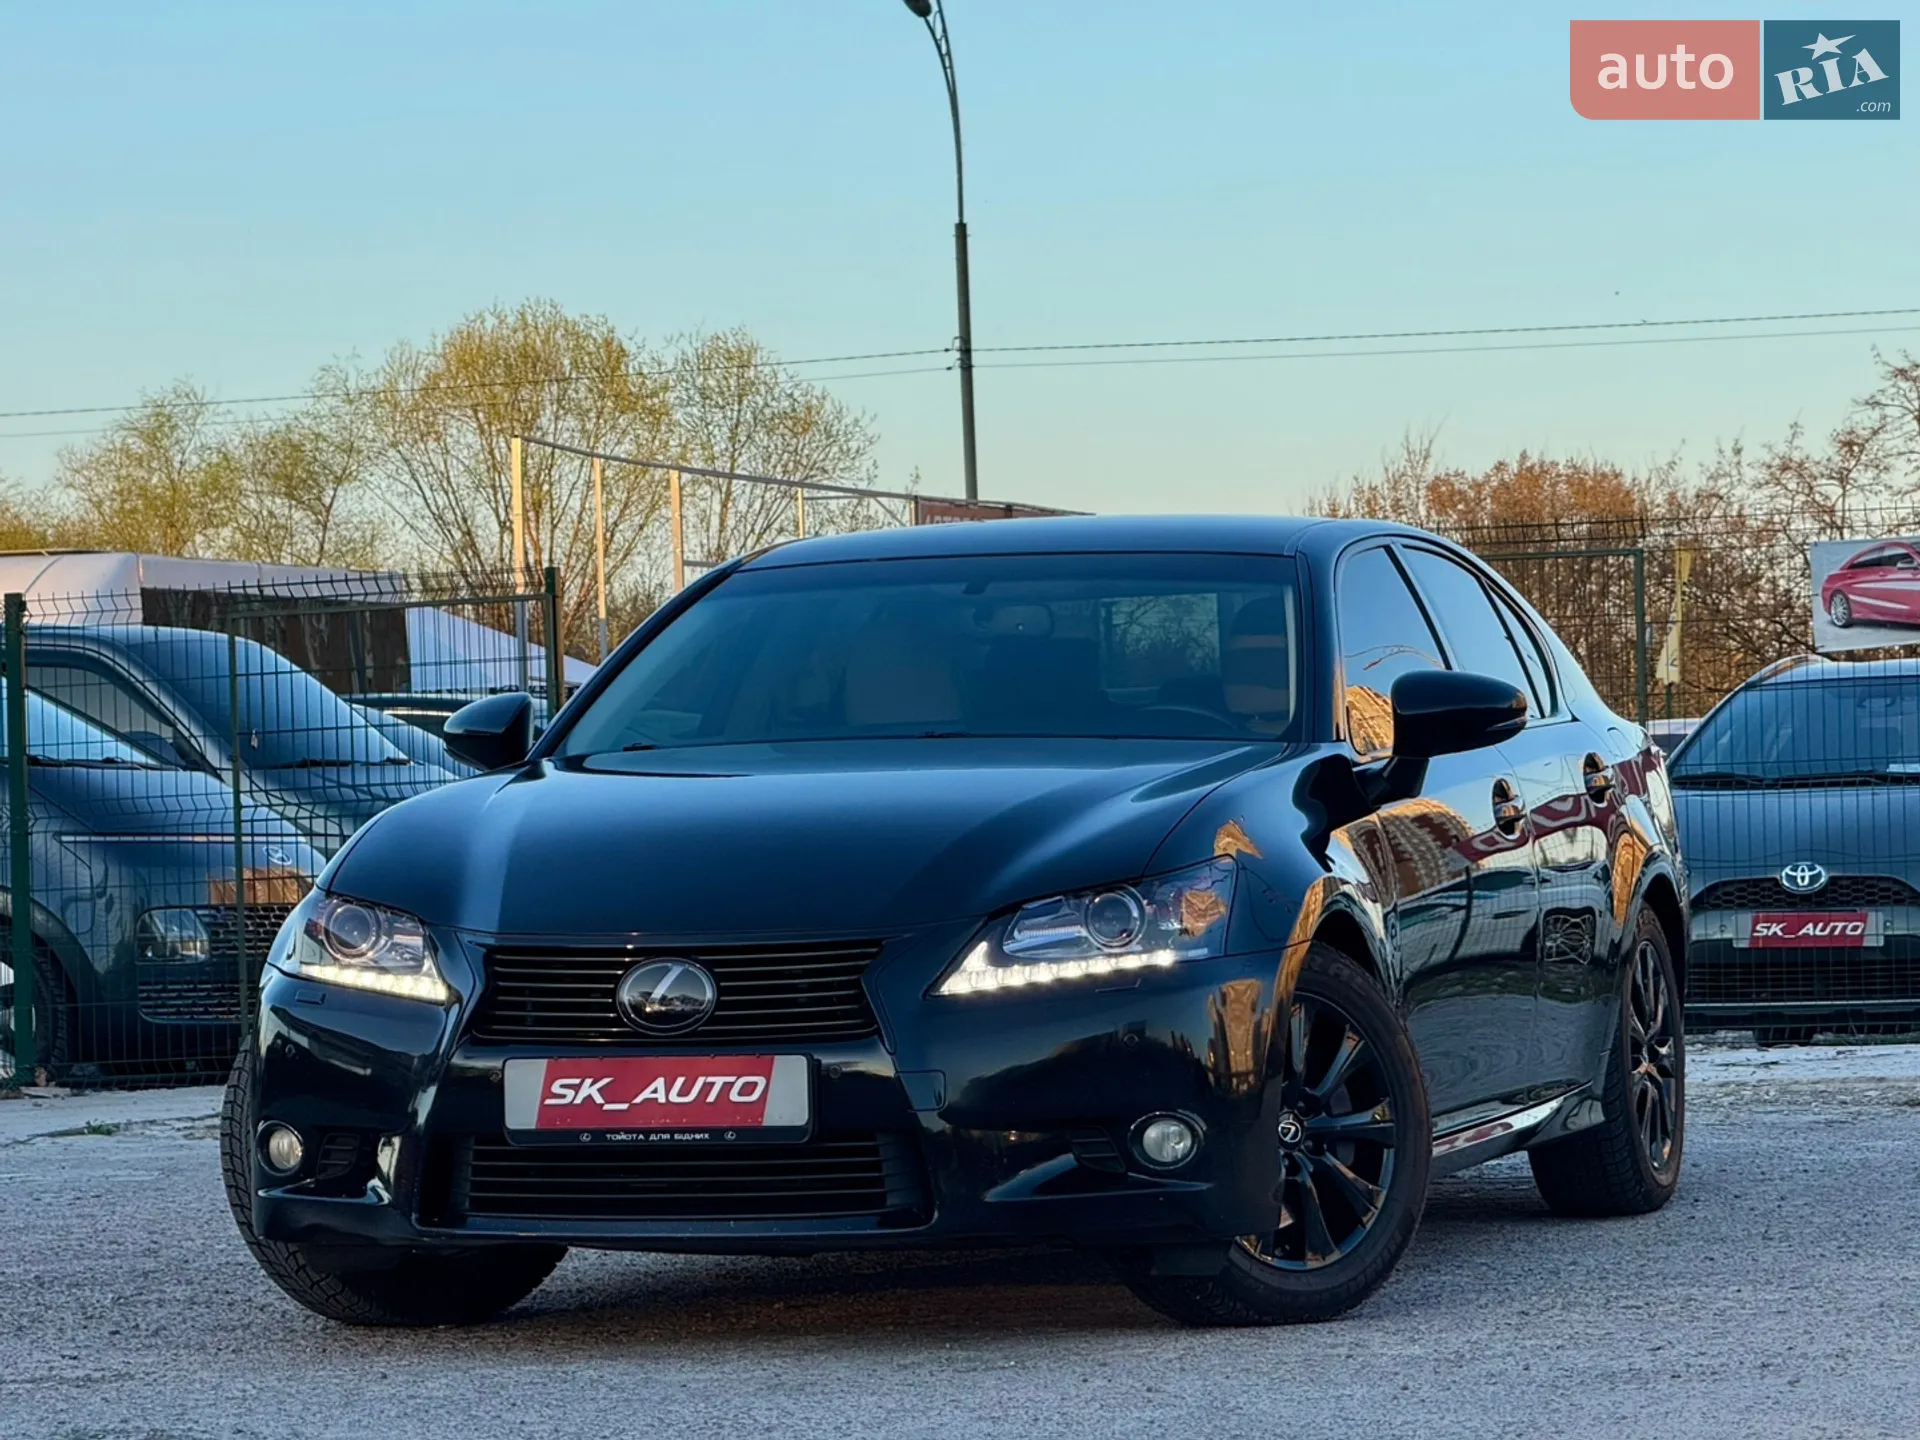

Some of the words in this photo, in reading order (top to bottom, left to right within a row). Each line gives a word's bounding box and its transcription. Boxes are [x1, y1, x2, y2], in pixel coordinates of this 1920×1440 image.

[1752, 921, 1865, 939] SK_AUTO
[543, 1075, 767, 1111] SK_AUTO
[605, 1131, 645, 1141] ТОЙОТА
